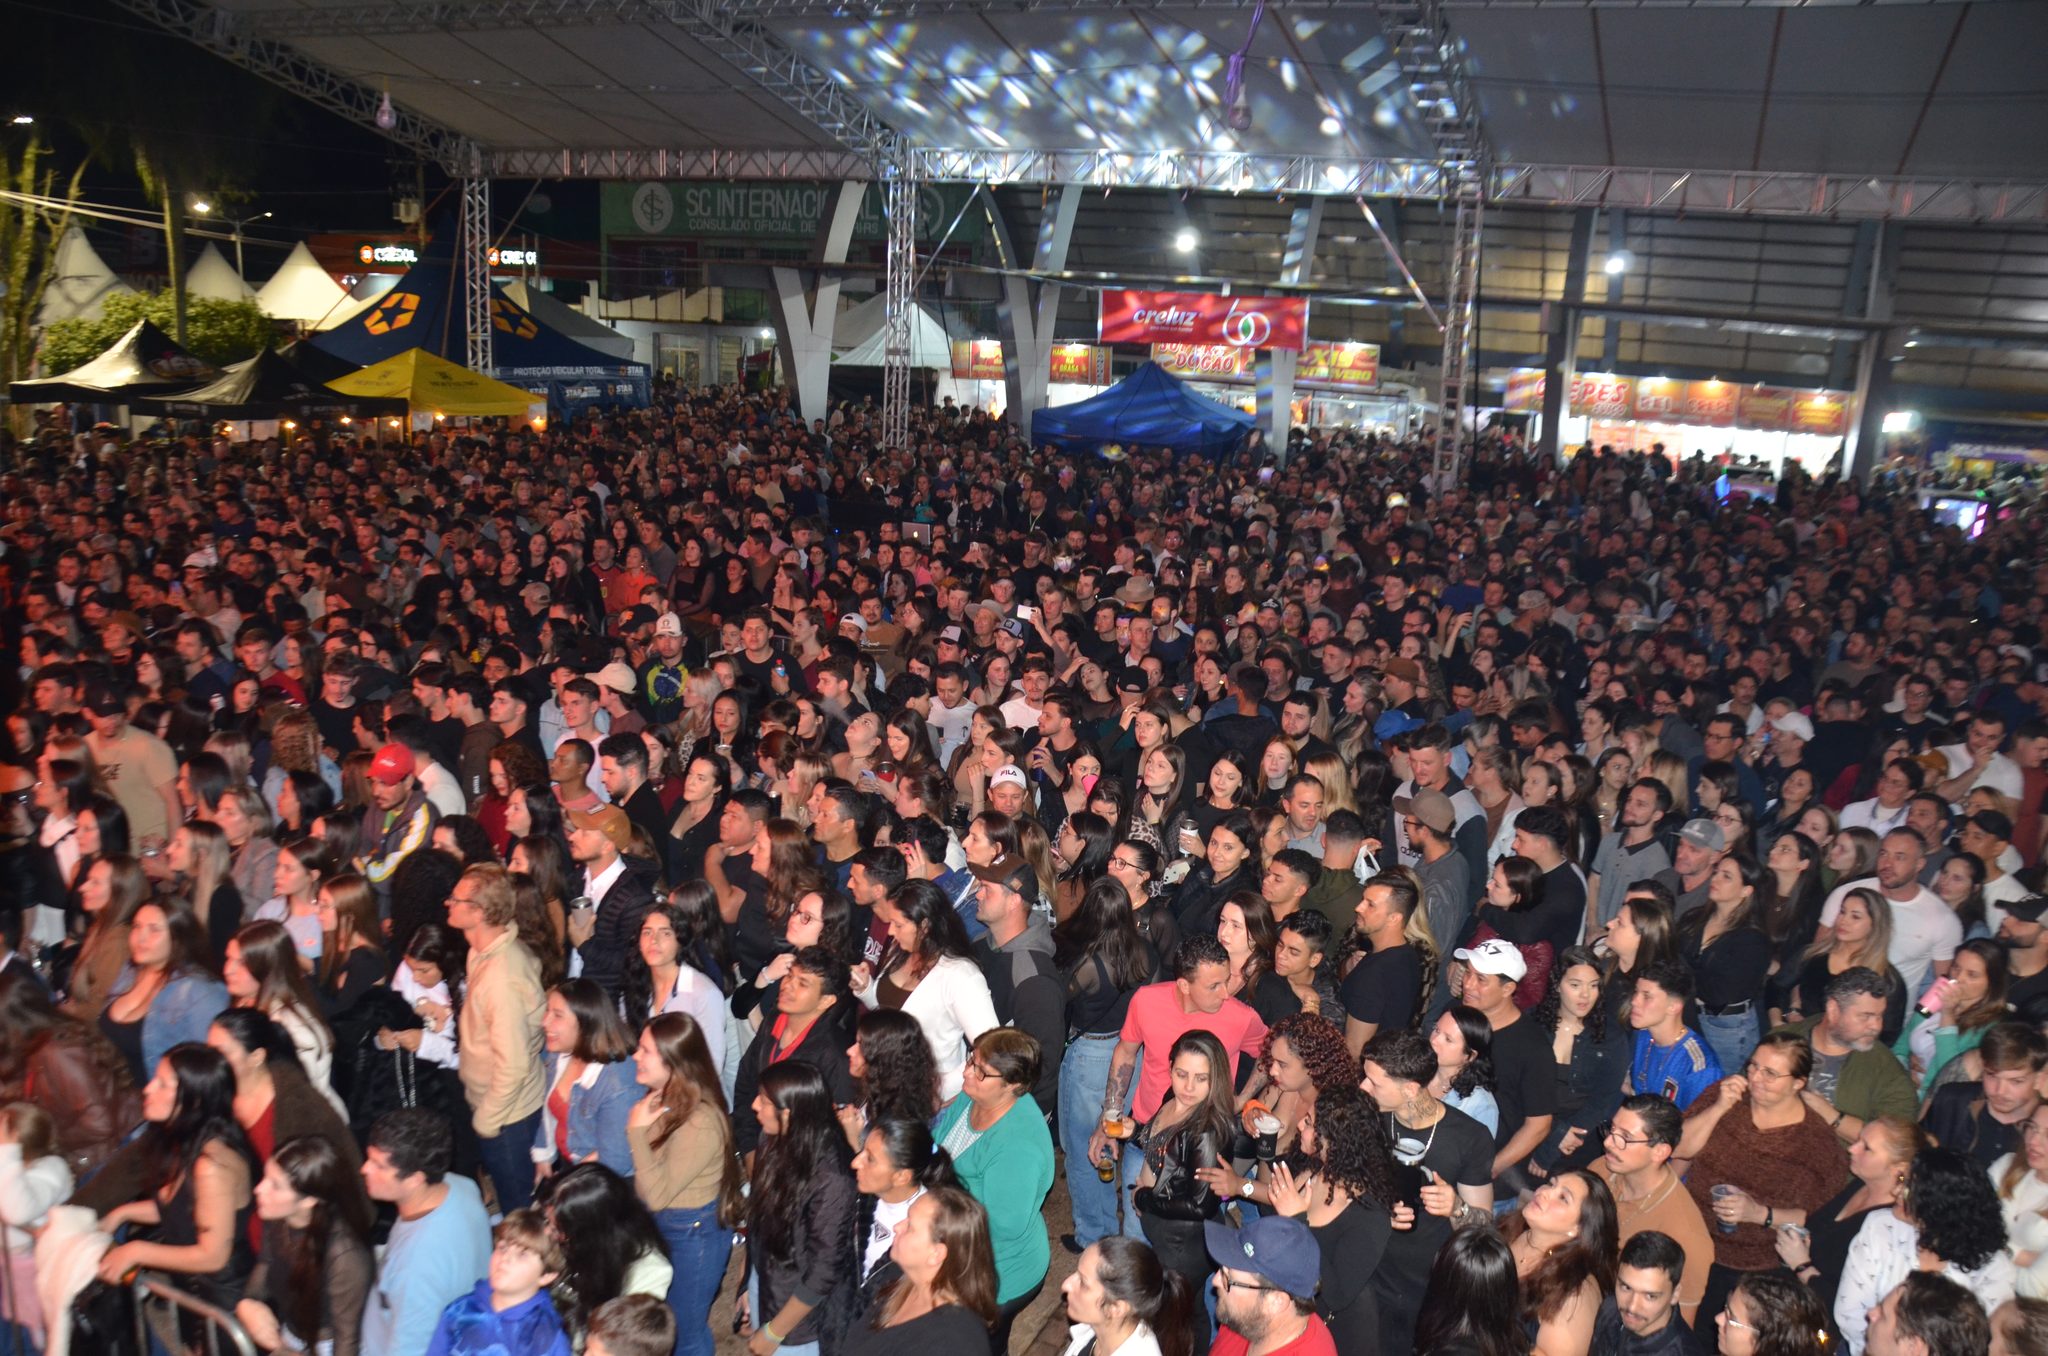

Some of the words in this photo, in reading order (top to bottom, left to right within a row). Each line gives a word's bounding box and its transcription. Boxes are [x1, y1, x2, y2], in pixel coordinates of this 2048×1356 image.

[686, 188, 712, 217] SC
[689, 217, 751, 232] CONSULADO
[754, 219, 795, 233] OFICIAL
[801, 220, 816, 233] DE
[1133, 305, 1196, 326] creluz
[513, 366, 551, 377] PROTEÇÃO
[552, 366, 584, 375] VEICULAR
[586, 366, 605, 375] TOTAL
[627, 366, 644, 375] STAR
[616, 384, 633, 393] STAR
[1000, 769, 1018, 777] FILA
